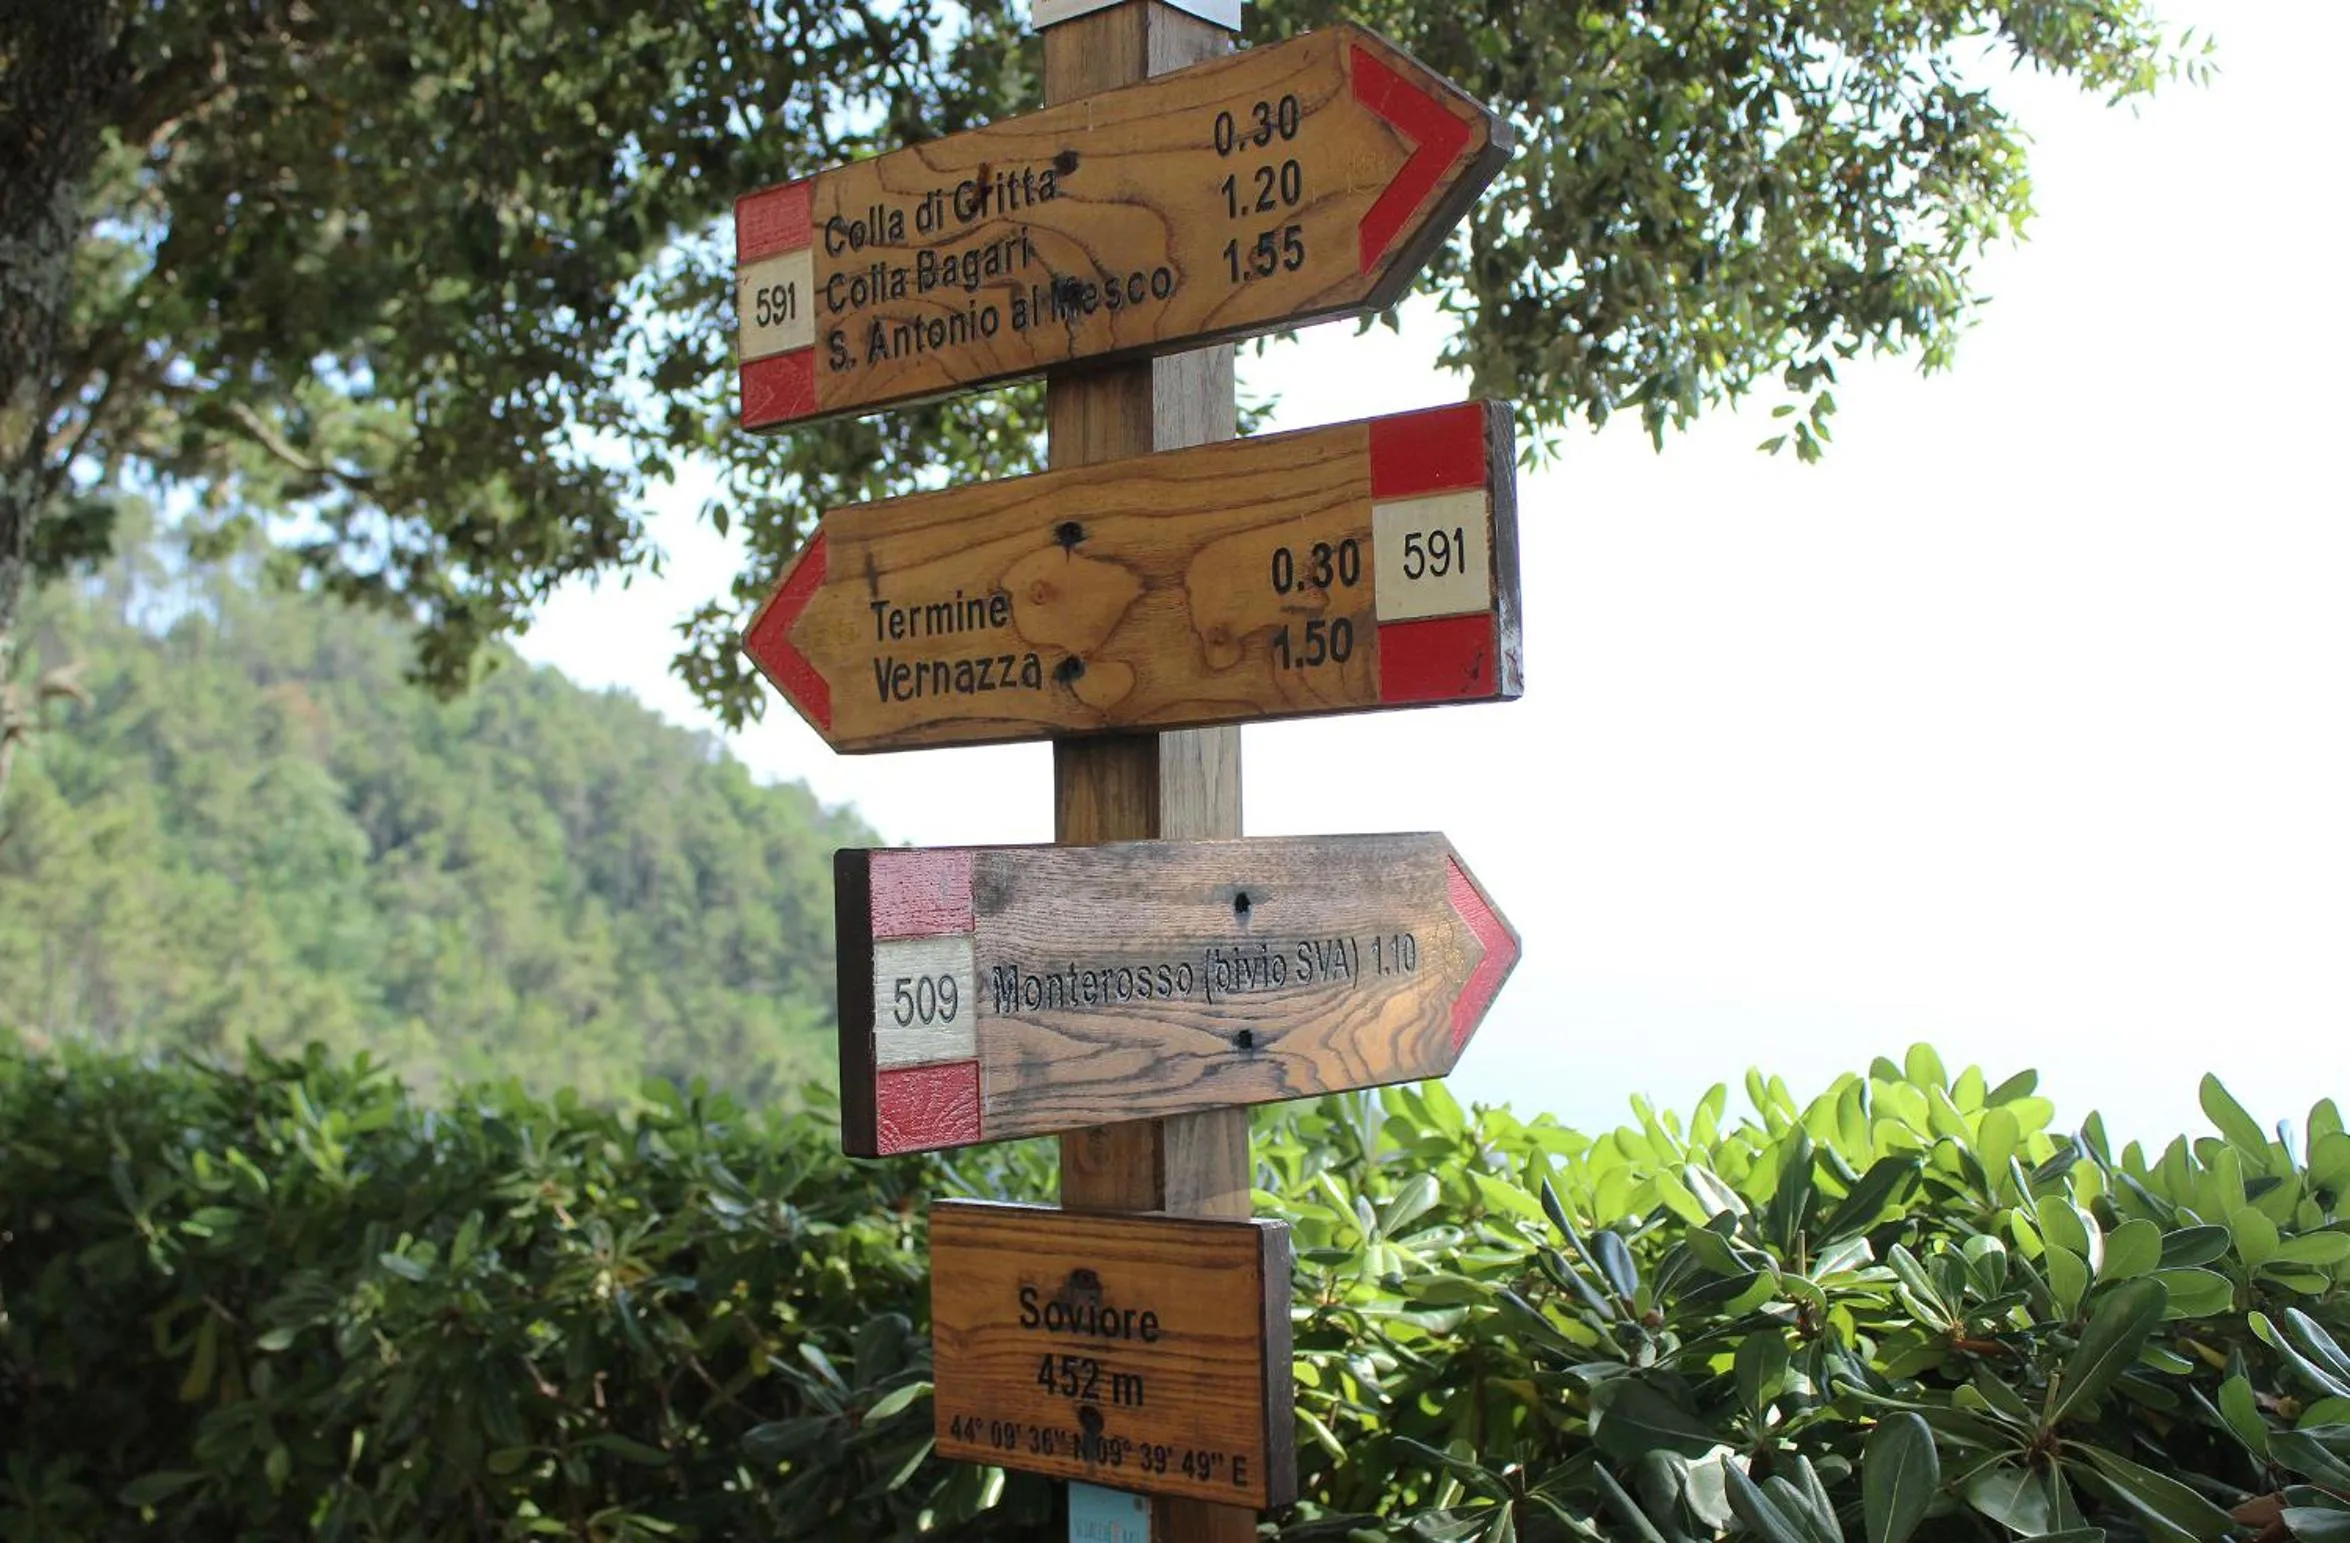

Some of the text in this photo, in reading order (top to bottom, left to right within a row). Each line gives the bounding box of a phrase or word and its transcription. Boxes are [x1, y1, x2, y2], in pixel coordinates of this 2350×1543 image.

[824, 94, 1300, 258] Colla di Gritta 0.30
[826, 160, 1302, 315] Colla Bagari 1.20
[755, 281, 797, 328] 591
[829, 331, 858, 374] S.
[868, 302, 999, 365] Antonio
[1011, 284, 1040, 329] al
[1223, 224, 1306, 284] 1.55
[871, 538, 1361, 641] Termine 0.30
[1403, 527, 1467, 580] 591
[874, 616, 1354, 702] Vernazza 1.50
[894, 974, 958, 1028] 509
[992, 931, 1416, 1016] Monterosso (bivio SVA) 1.10
[1019, 1286, 1160, 1343] Soviore
[1038, 1353, 1144, 1406] 452 m
[951, 1415, 983, 1443] 44°
[1140, 1444, 1173, 1475] 39'
[1232, 1455, 1248, 1488] E
